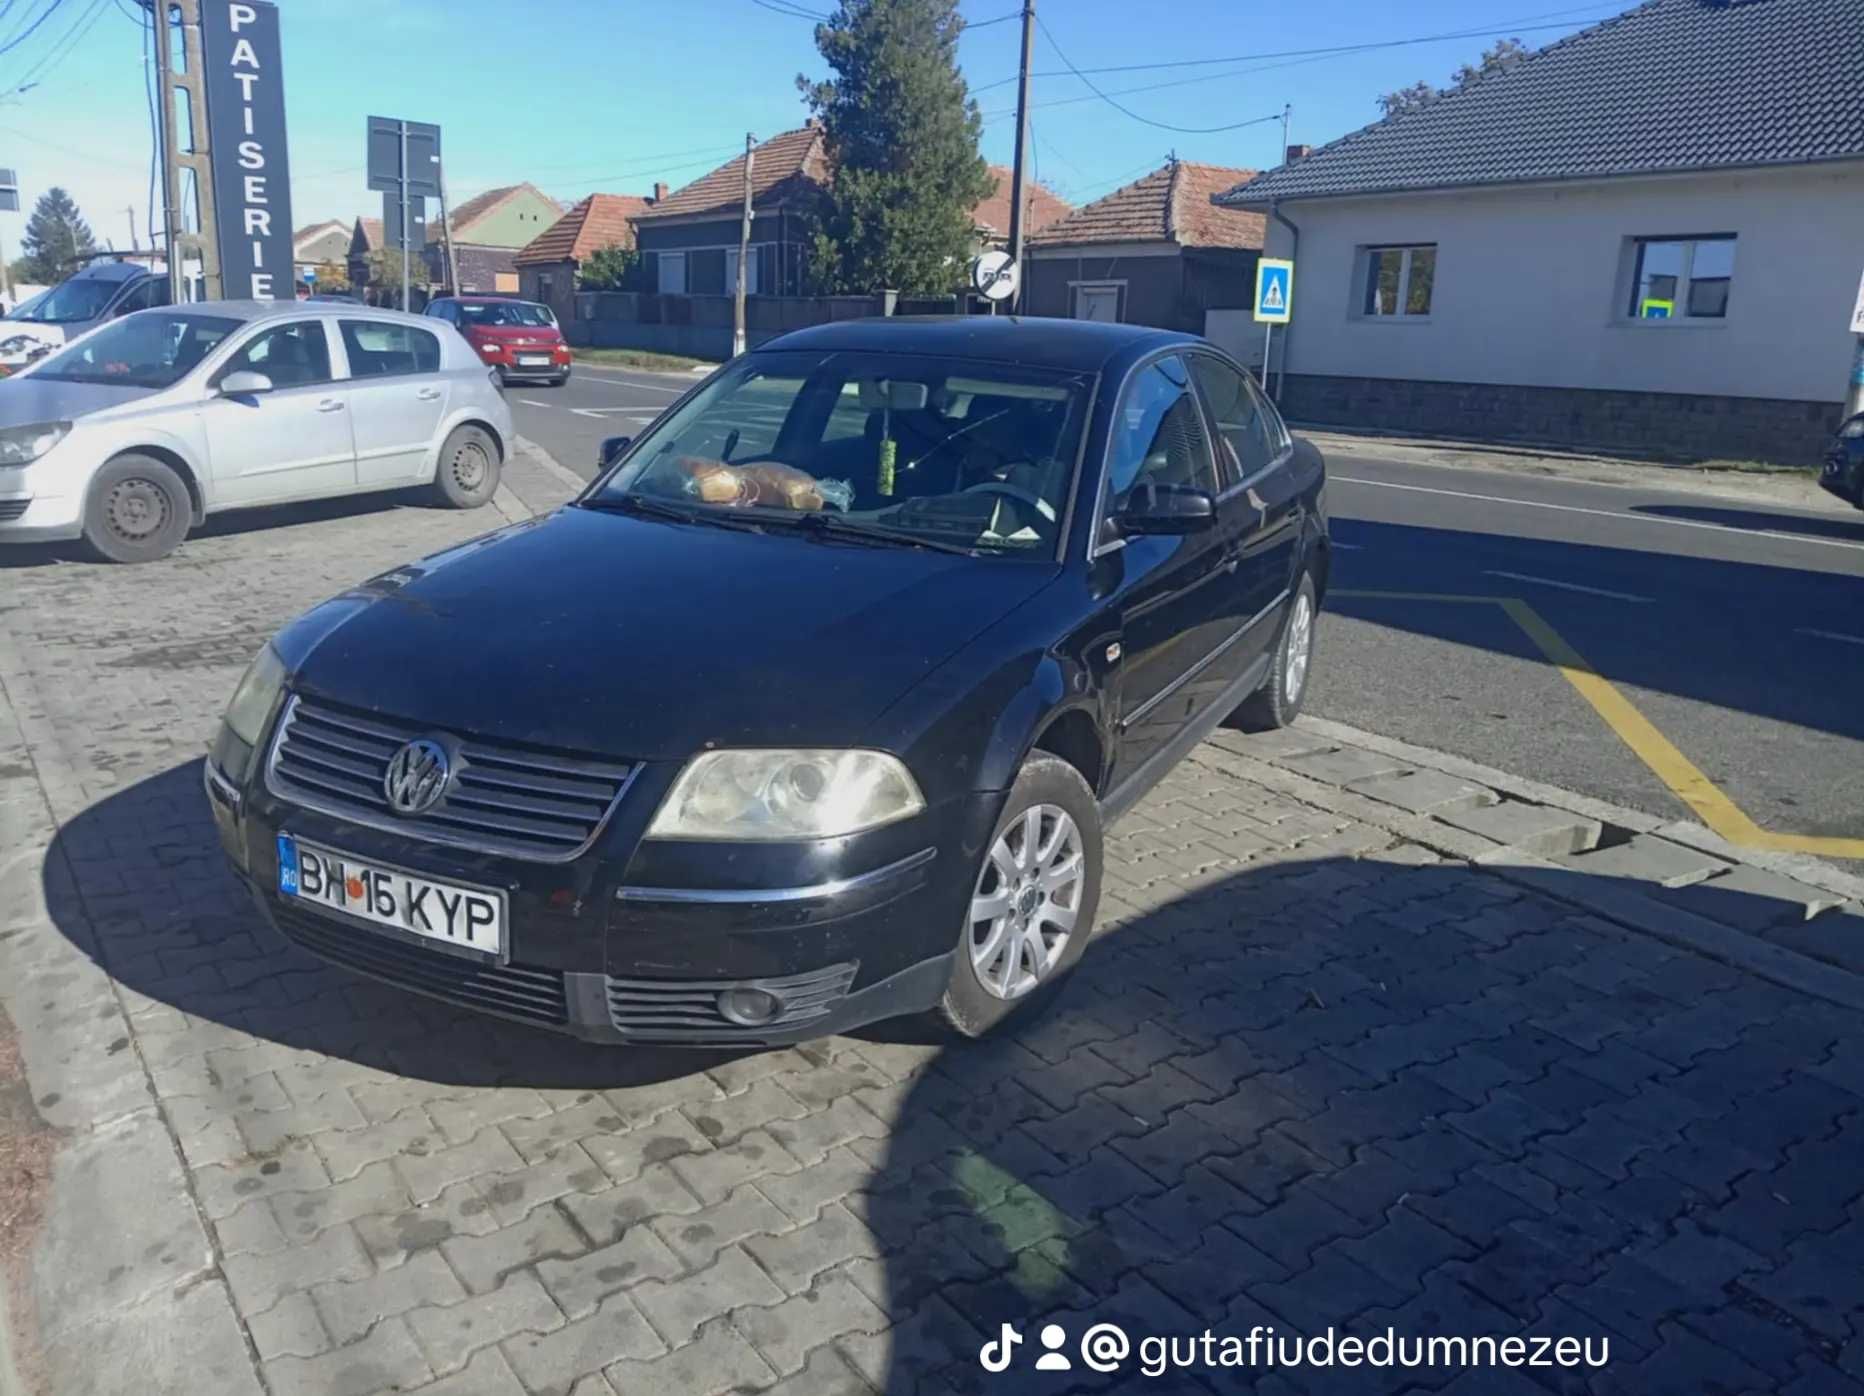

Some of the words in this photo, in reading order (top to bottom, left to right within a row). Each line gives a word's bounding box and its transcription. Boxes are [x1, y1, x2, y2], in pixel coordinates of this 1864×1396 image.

[229, 3, 275, 300] PATISERIE
[299, 851, 347, 906] BH
[361, 869, 396, 917] 15
[406, 881, 495, 940] KYP
